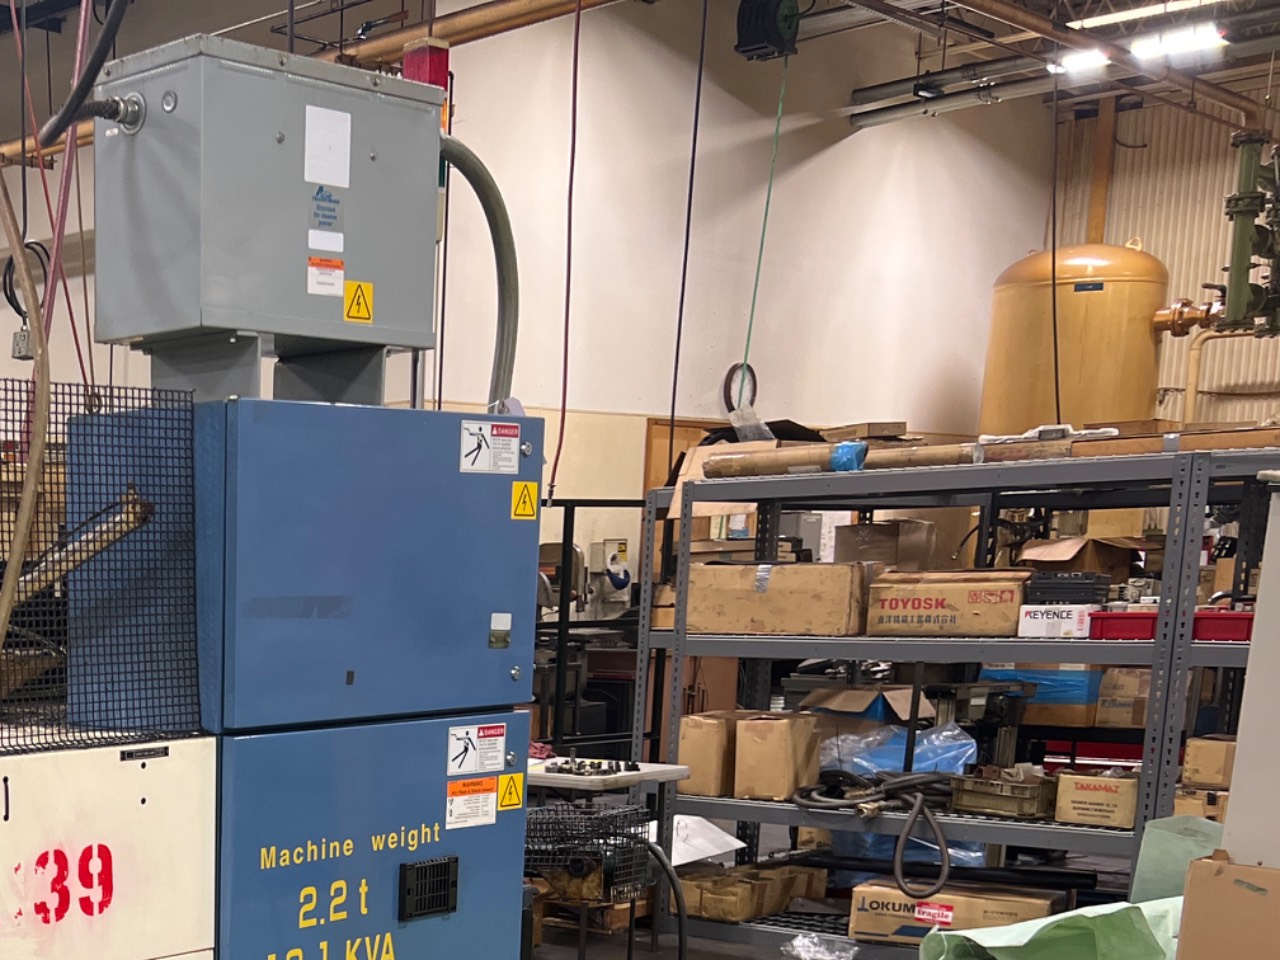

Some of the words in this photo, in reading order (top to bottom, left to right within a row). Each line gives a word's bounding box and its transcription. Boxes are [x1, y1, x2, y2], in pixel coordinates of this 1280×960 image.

[498, 428, 518, 436] DANGER
[879, 597, 947, 610] TOYOSK
[1025, 610, 1073, 619] KEYENCE
[484, 727, 504, 736] DANGER
[1073, 781, 1120, 793] TAKAMAZ
[260, 838, 354, 870] Machine
[371, 822, 440, 851] weight
[34, 843, 113, 924] 39
[299, 879, 348, 928] 2.2
[359, 878, 368, 915] t
[869, 900, 916, 913] OKUM
